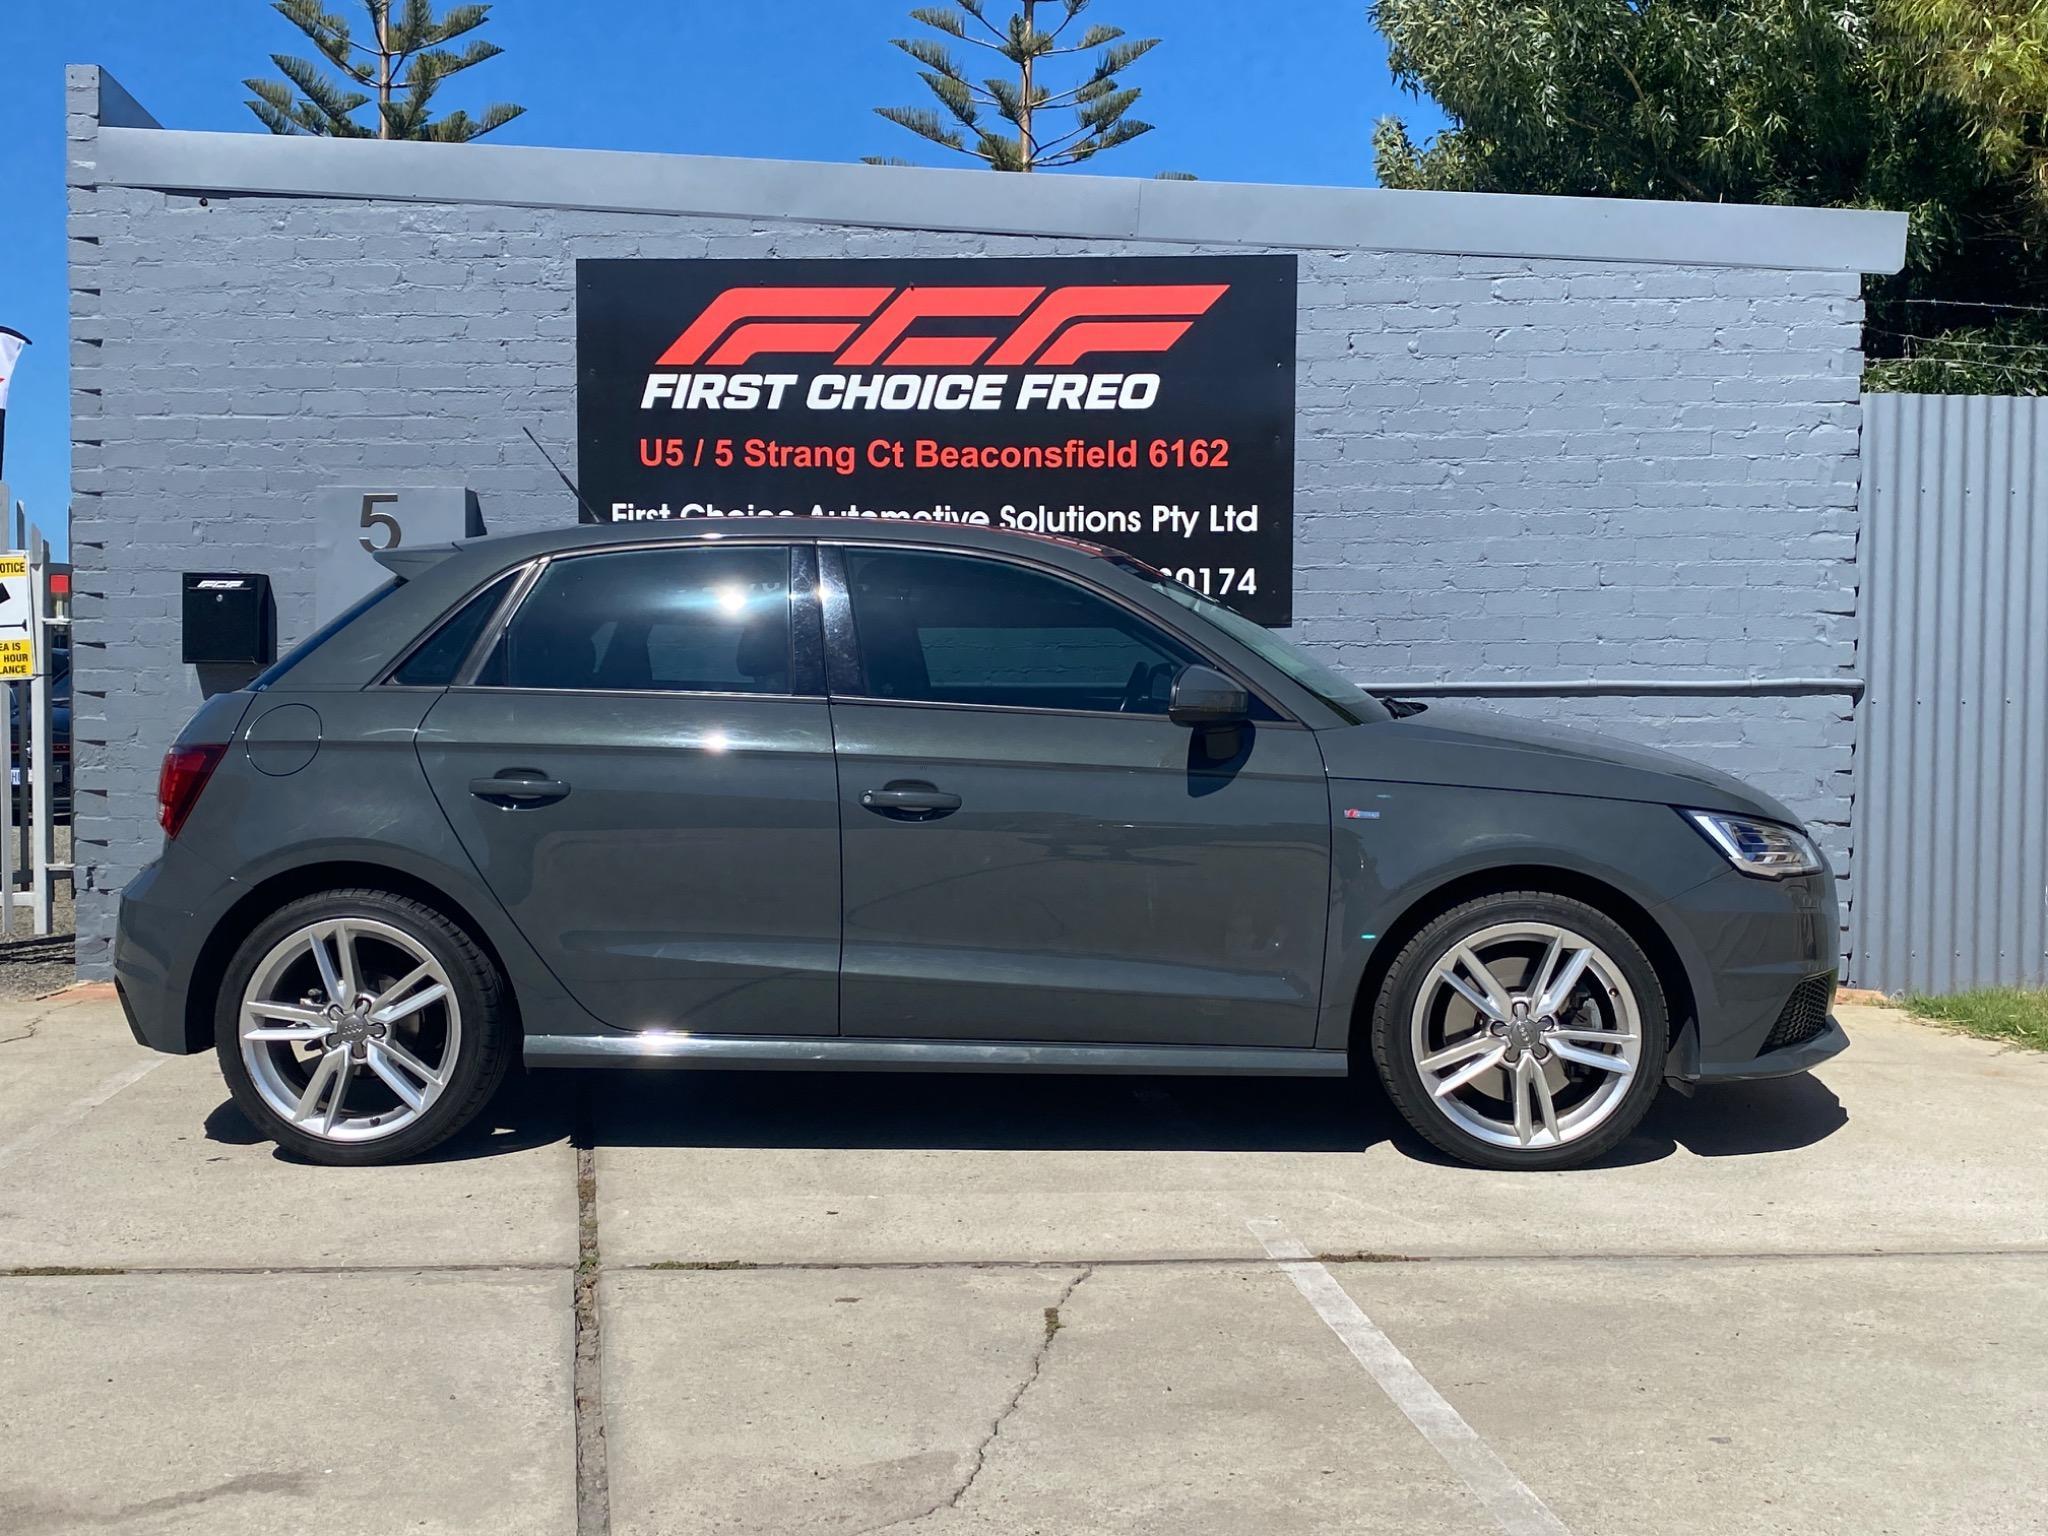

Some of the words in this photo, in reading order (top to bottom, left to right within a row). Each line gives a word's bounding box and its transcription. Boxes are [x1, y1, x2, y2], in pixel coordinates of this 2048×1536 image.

[655, 284, 1230, 367] FCF
[641, 373, 799, 410] FIRST
[806, 373, 1009, 410] CHOICE
[1015, 373, 1161, 410] FREO
[640, 438, 684, 467] U5
[693, 438, 706, 467] /
[715, 438, 734, 467] 5
[744, 438, 855, 475] Strang
[867, 439, 904, 468] Ct
[915, 439, 1137, 468] Beaconsfield
[1149, 438, 1229, 468] 6162
[358, 493, 402, 553] 5
[999, 504, 1142, 533] Solutions
[1152, 505, 1200, 538] Pty
[1210, 504, 1258, 532] Ltd
[0, 562, 25, 573] OTICE
[1158, 567, 1257, 595] 0174
[3, 653, 29, 663] HOUR
[12, 642, 21, 651] IS
[0, 665, 26, 675] ANCE
